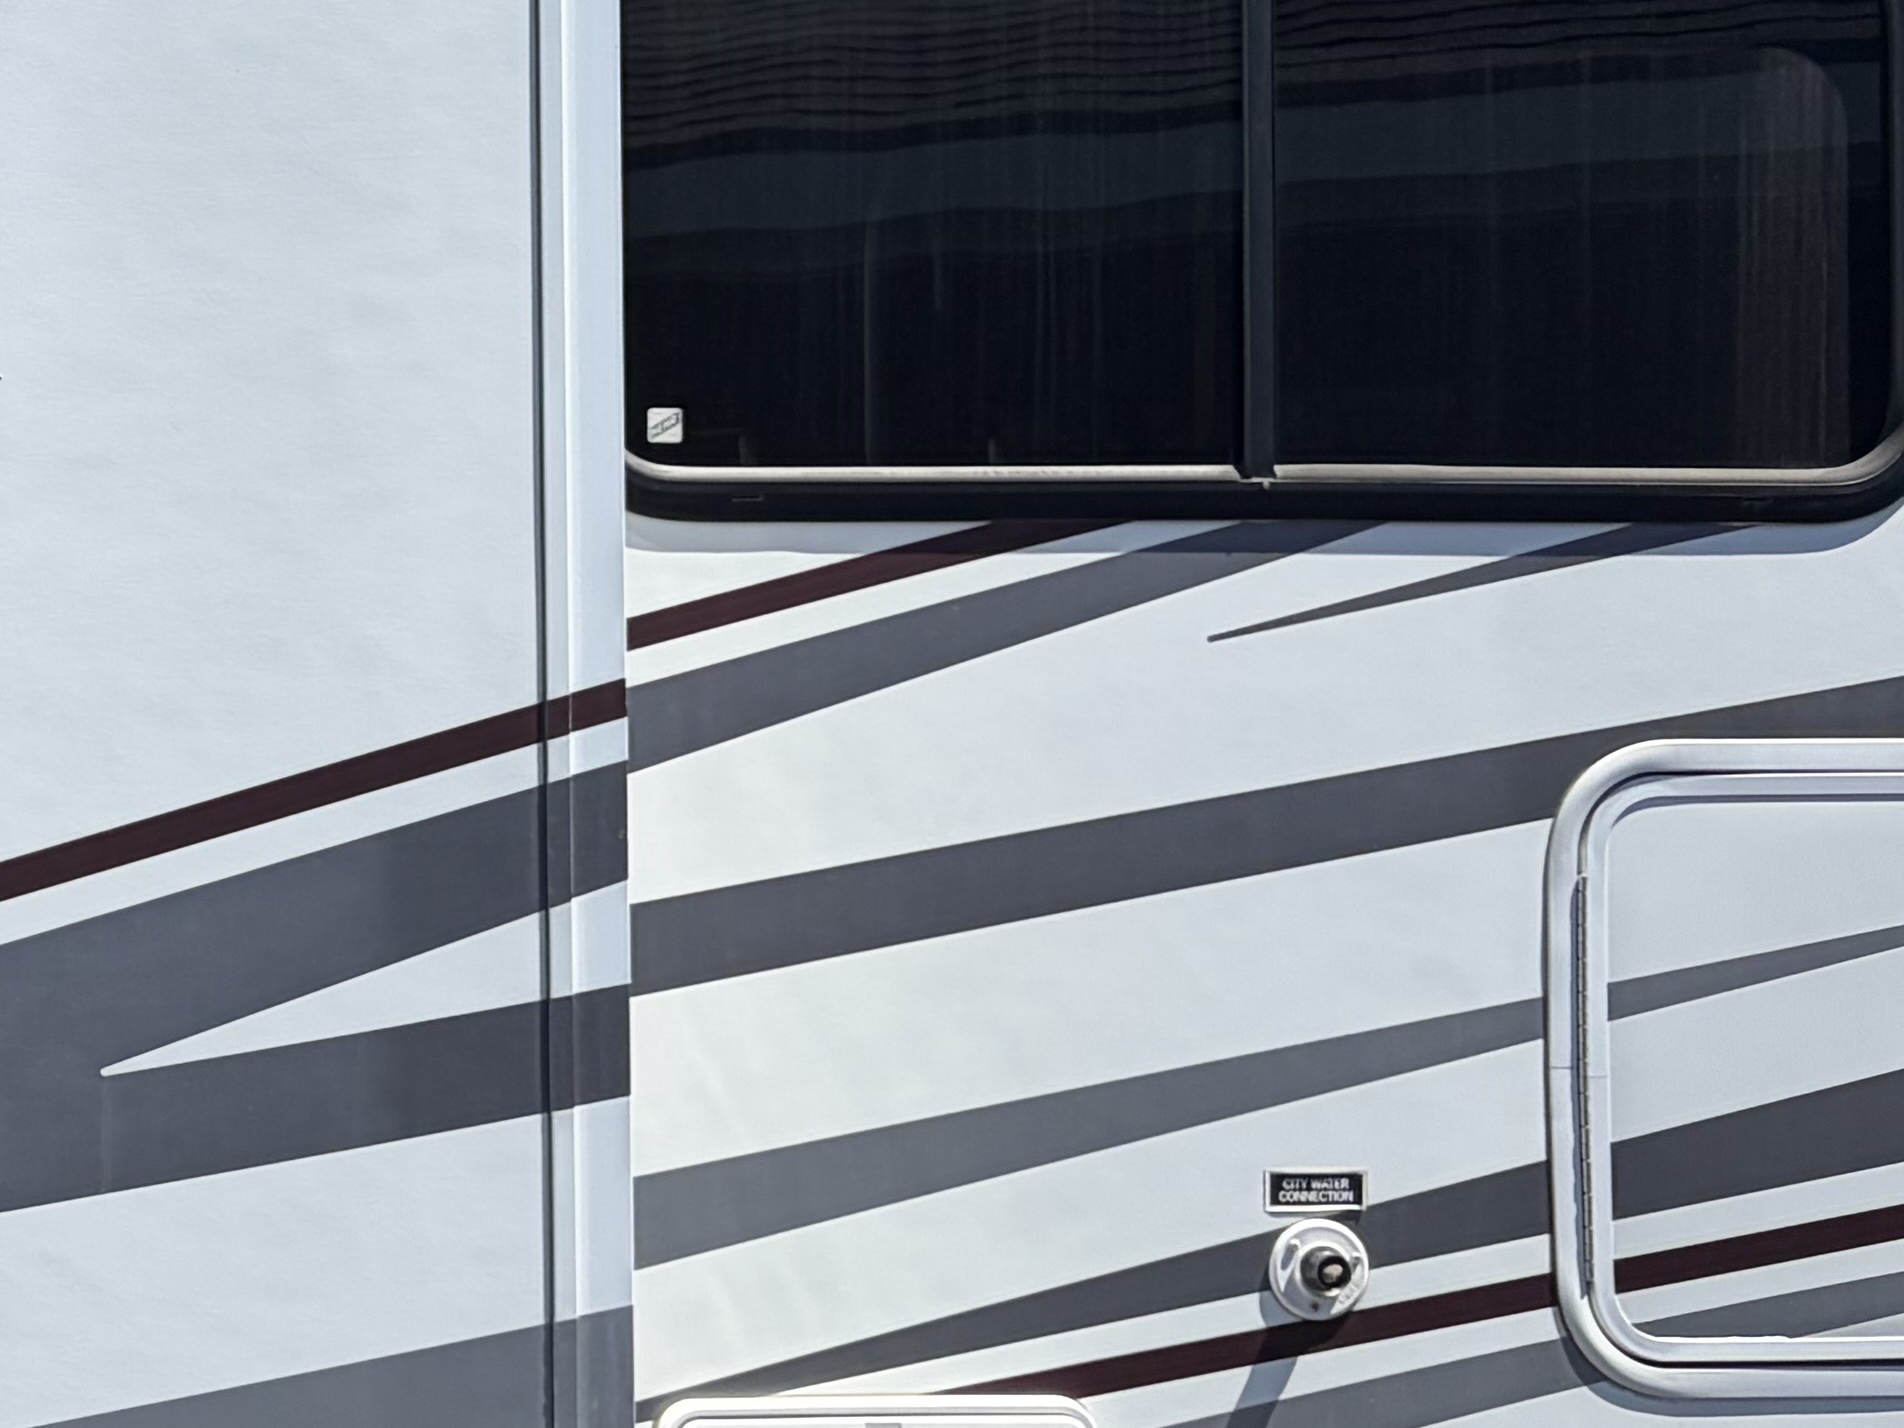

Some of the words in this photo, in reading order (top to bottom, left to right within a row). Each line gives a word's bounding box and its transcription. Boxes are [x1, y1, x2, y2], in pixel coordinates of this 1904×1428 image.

[1281, 1177, 1309, 1190] CITY
[1310, 1177, 1350, 1190] WATER
[1278, 1189, 1354, 1202] CONNECTION
